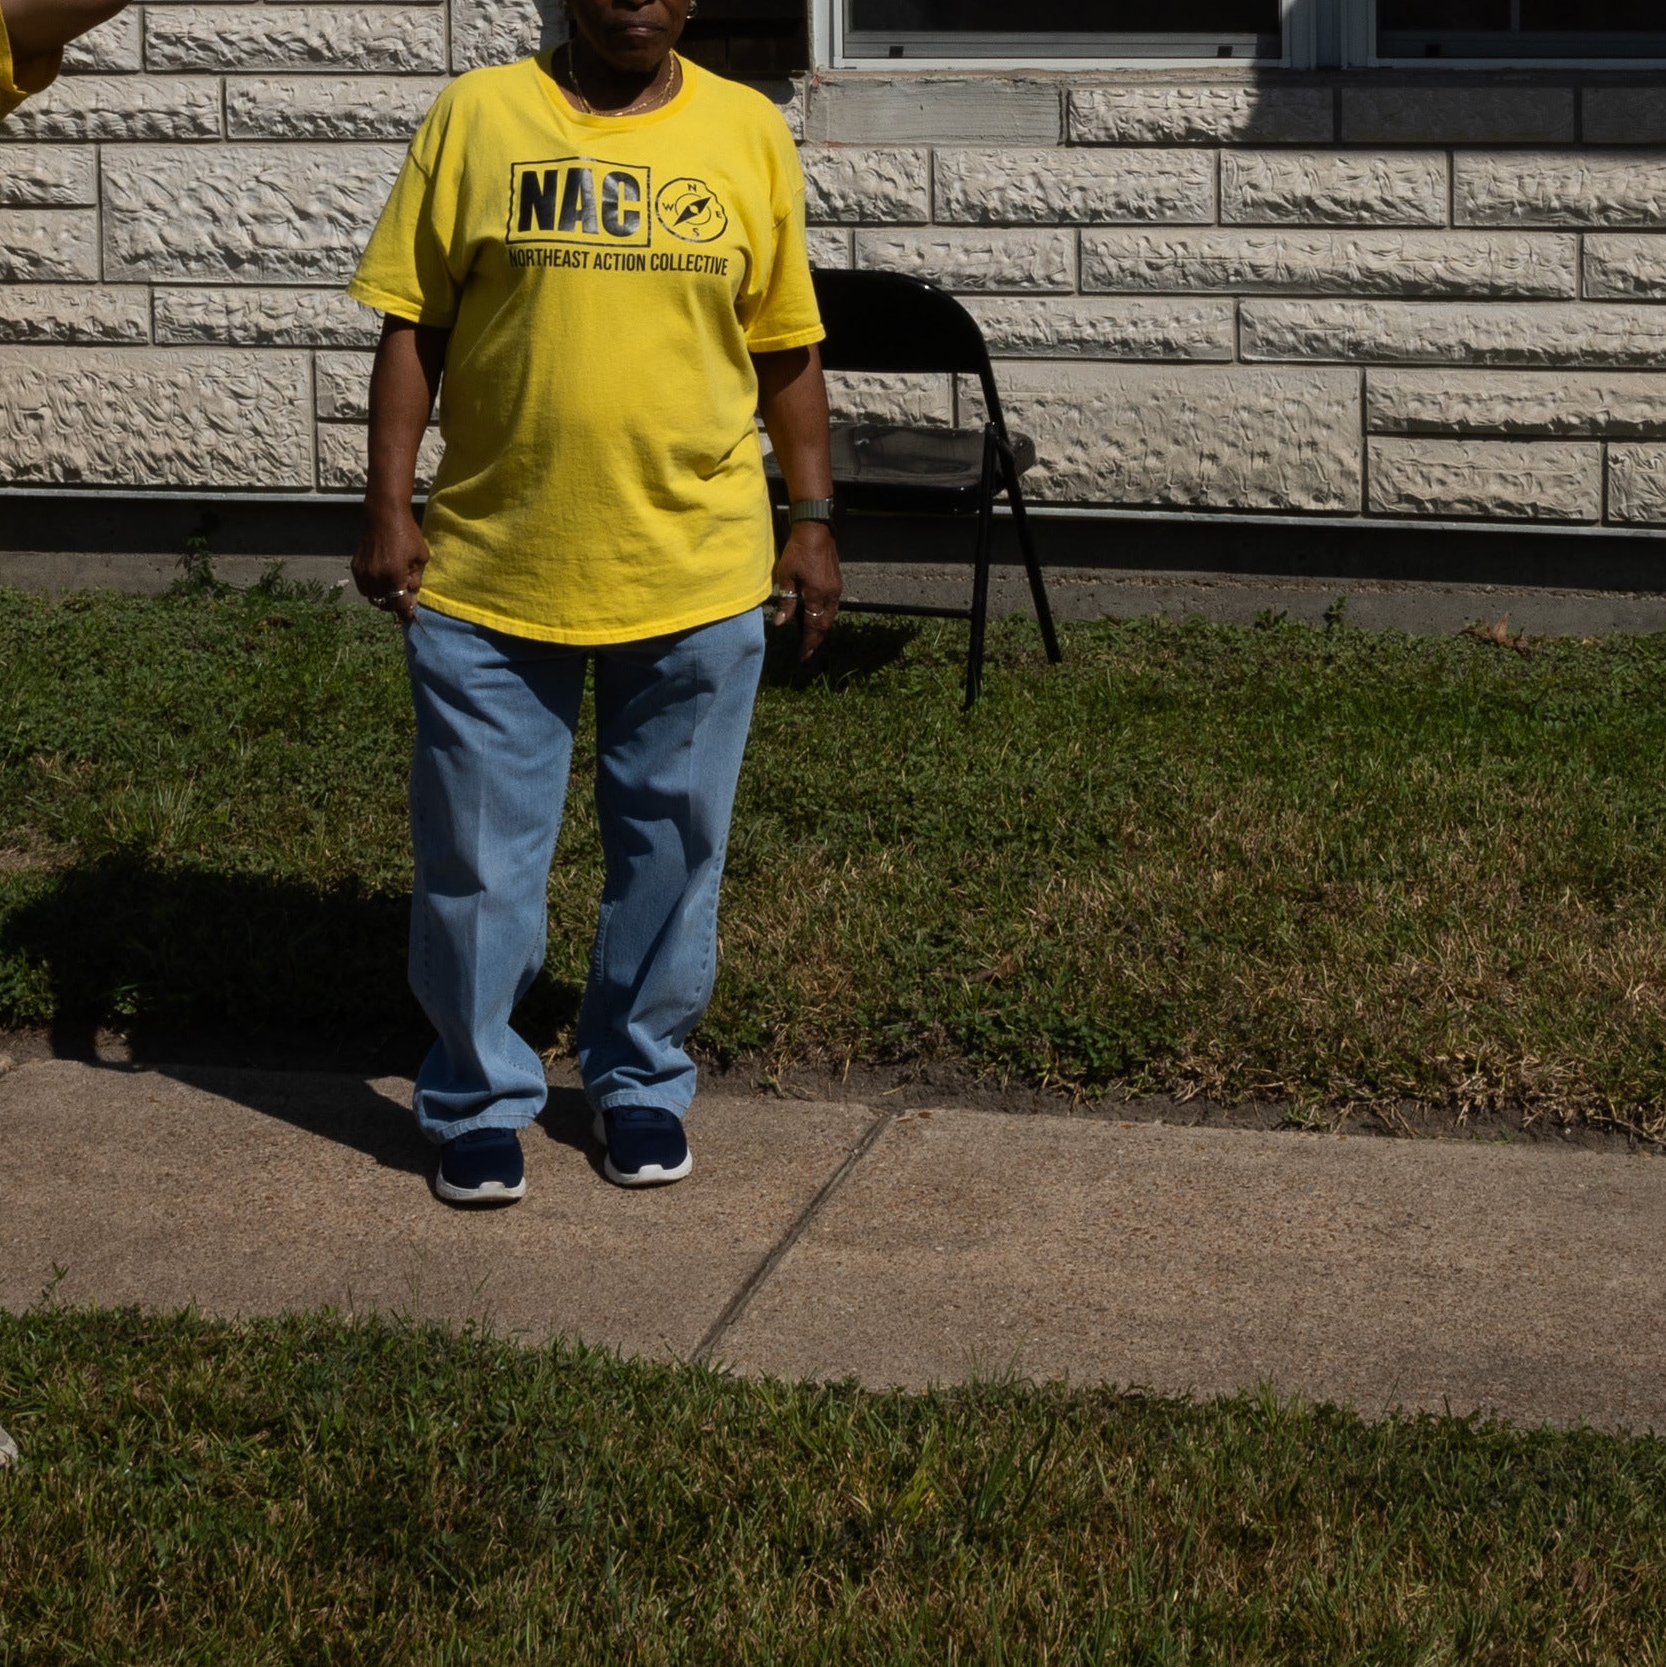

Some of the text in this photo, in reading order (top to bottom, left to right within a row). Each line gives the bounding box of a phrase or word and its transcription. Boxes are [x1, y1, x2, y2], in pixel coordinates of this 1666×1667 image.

[687, 183, 697, 192] N
[518, 167, 641, 237] NAC
[662, 202, 673, 212] W
[508, 249, 729, 277] NORTHEAST ACTION COLLECTIVE
